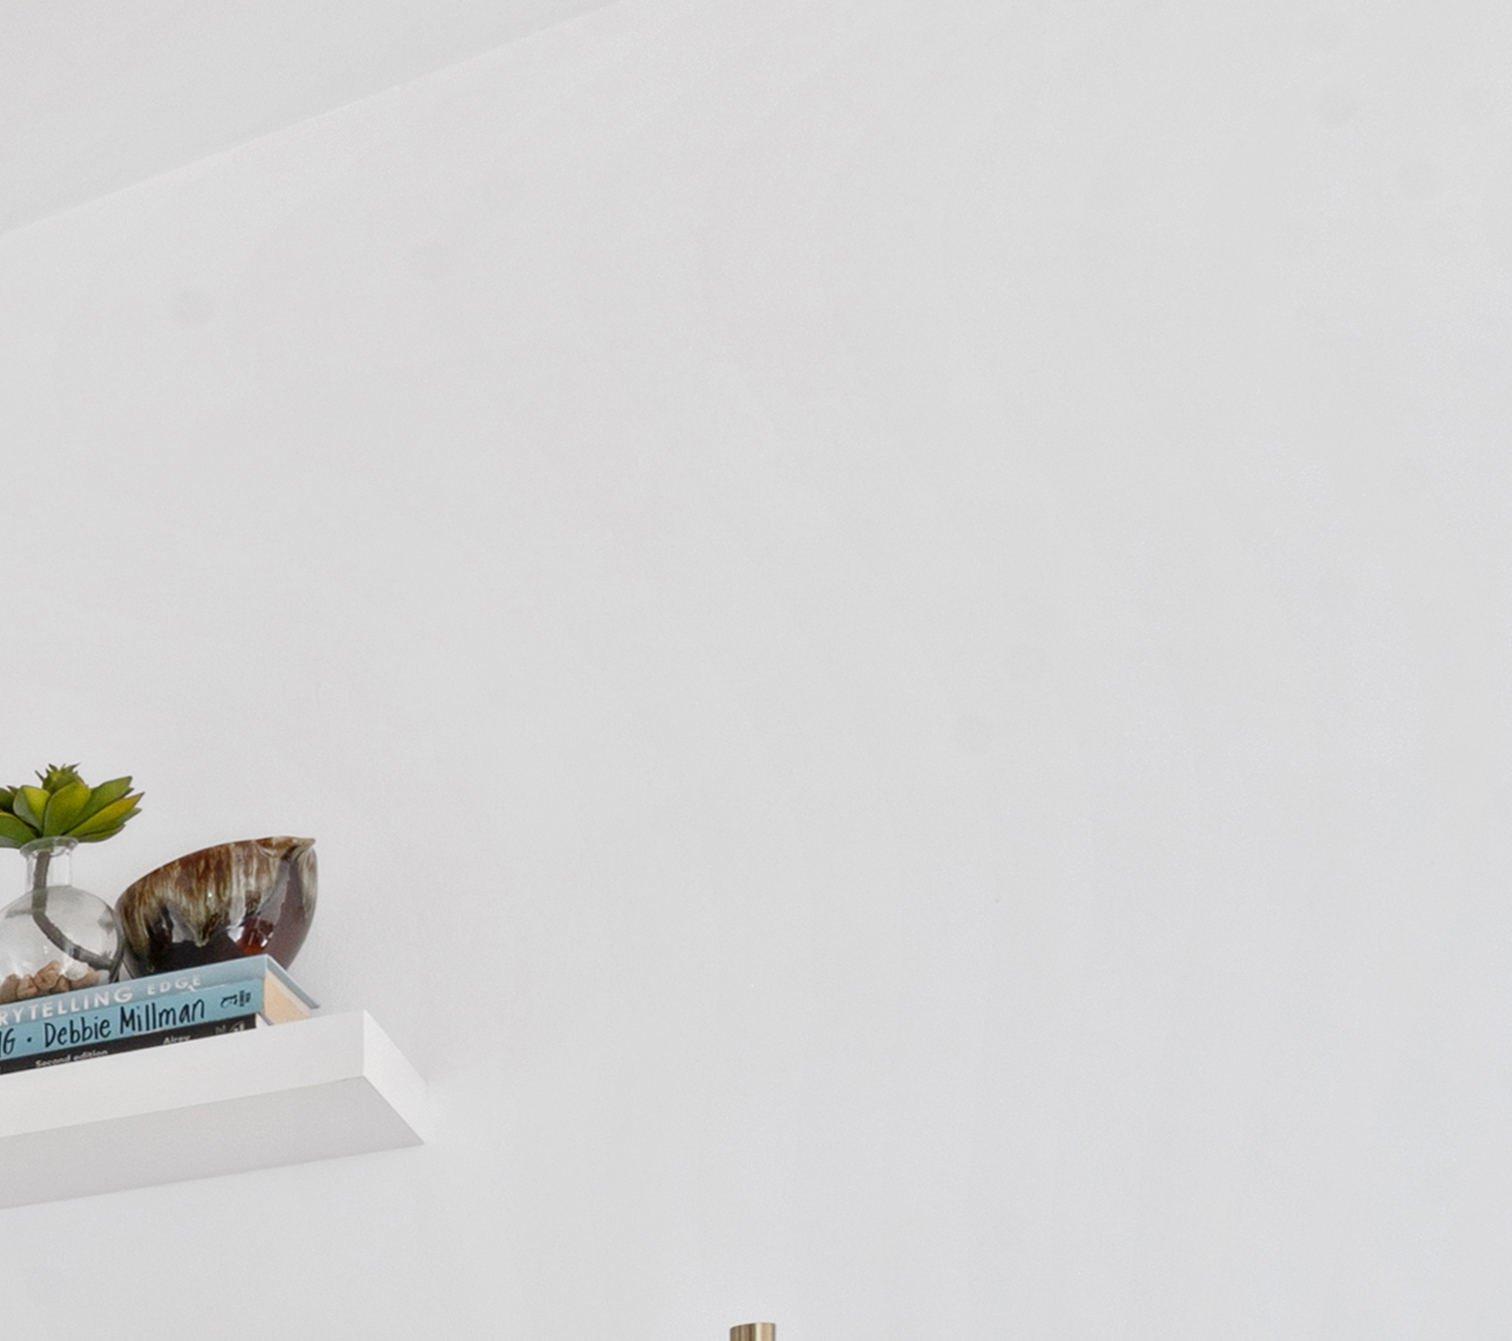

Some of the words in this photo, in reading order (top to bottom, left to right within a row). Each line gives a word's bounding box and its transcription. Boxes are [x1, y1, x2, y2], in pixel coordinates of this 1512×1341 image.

[146, 975, 202, 996] EDGE
[44, 1016, 112, 1048] Debbie
[119, 998, 205, 1035] Millman
